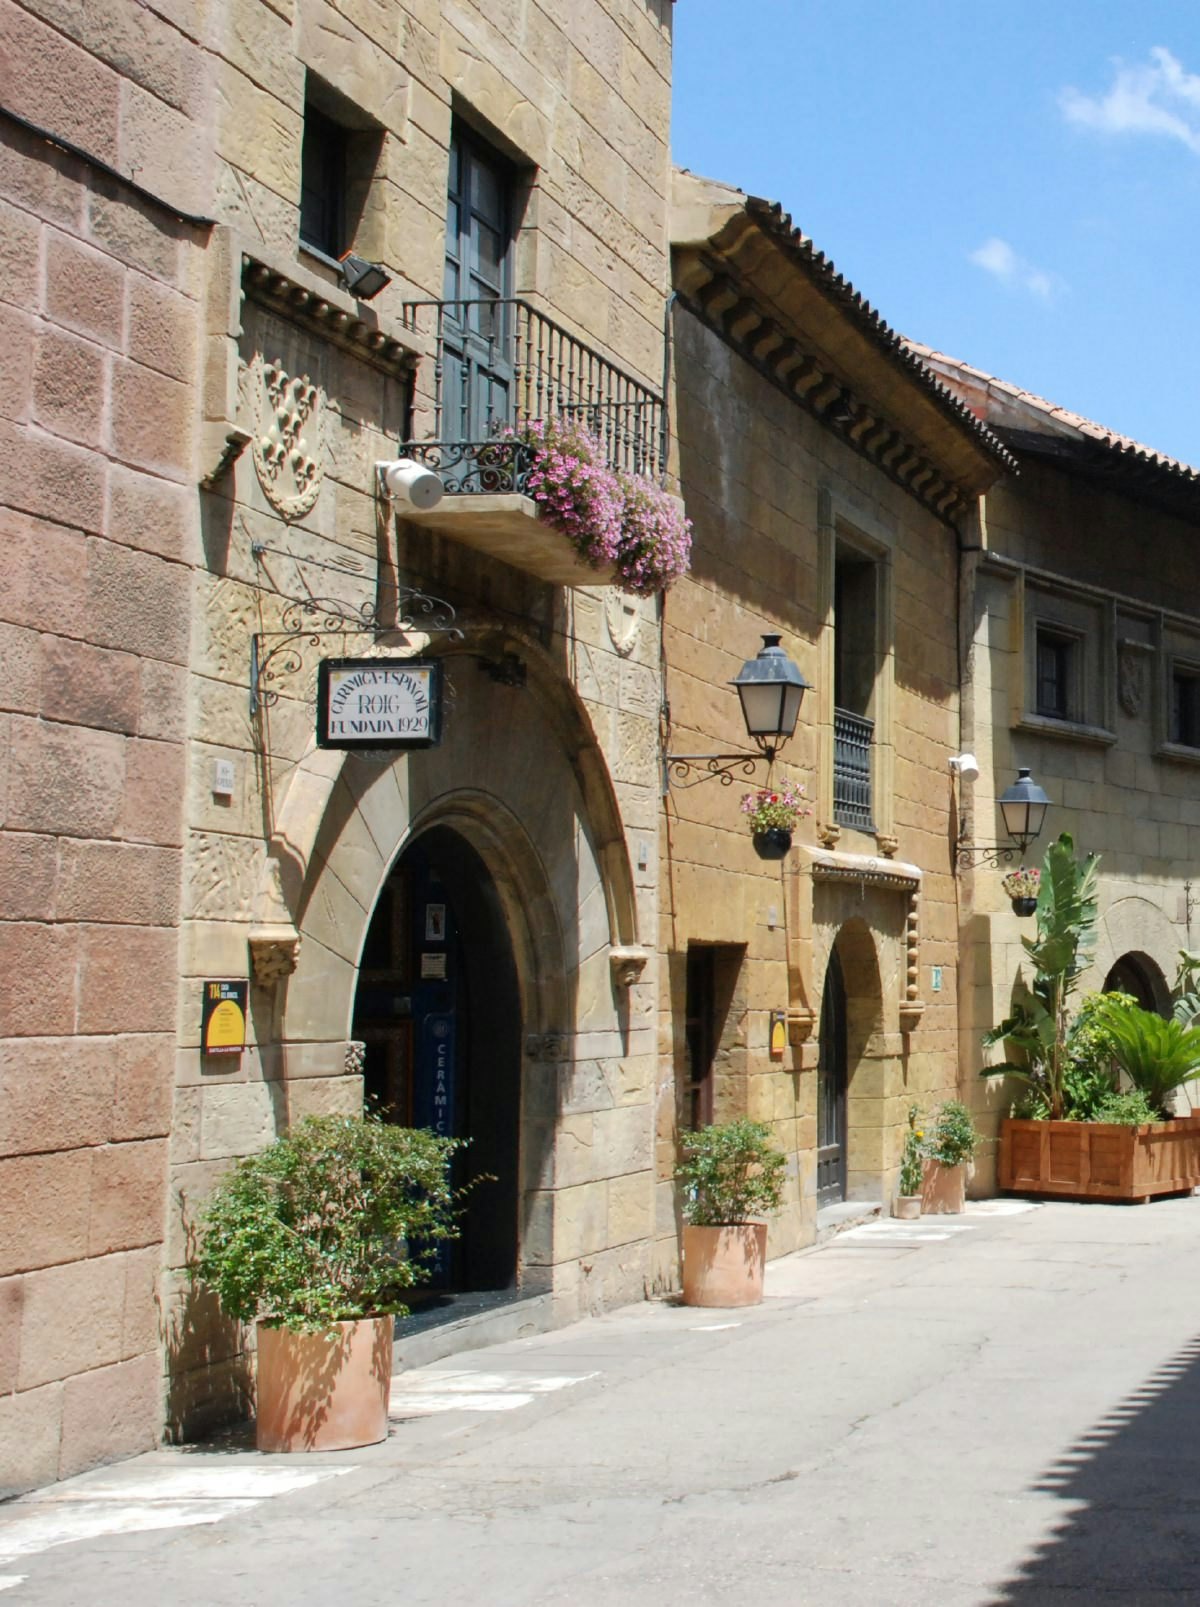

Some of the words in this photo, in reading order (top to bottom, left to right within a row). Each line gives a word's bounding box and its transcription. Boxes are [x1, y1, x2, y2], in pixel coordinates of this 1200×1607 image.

[358, 694, 400, 714] ROIG
[330, 720, 394, 734] FUNDADA
[397, 717, 428, 732] 1929
[434, 1044, 447, 1137] CERAMIC
